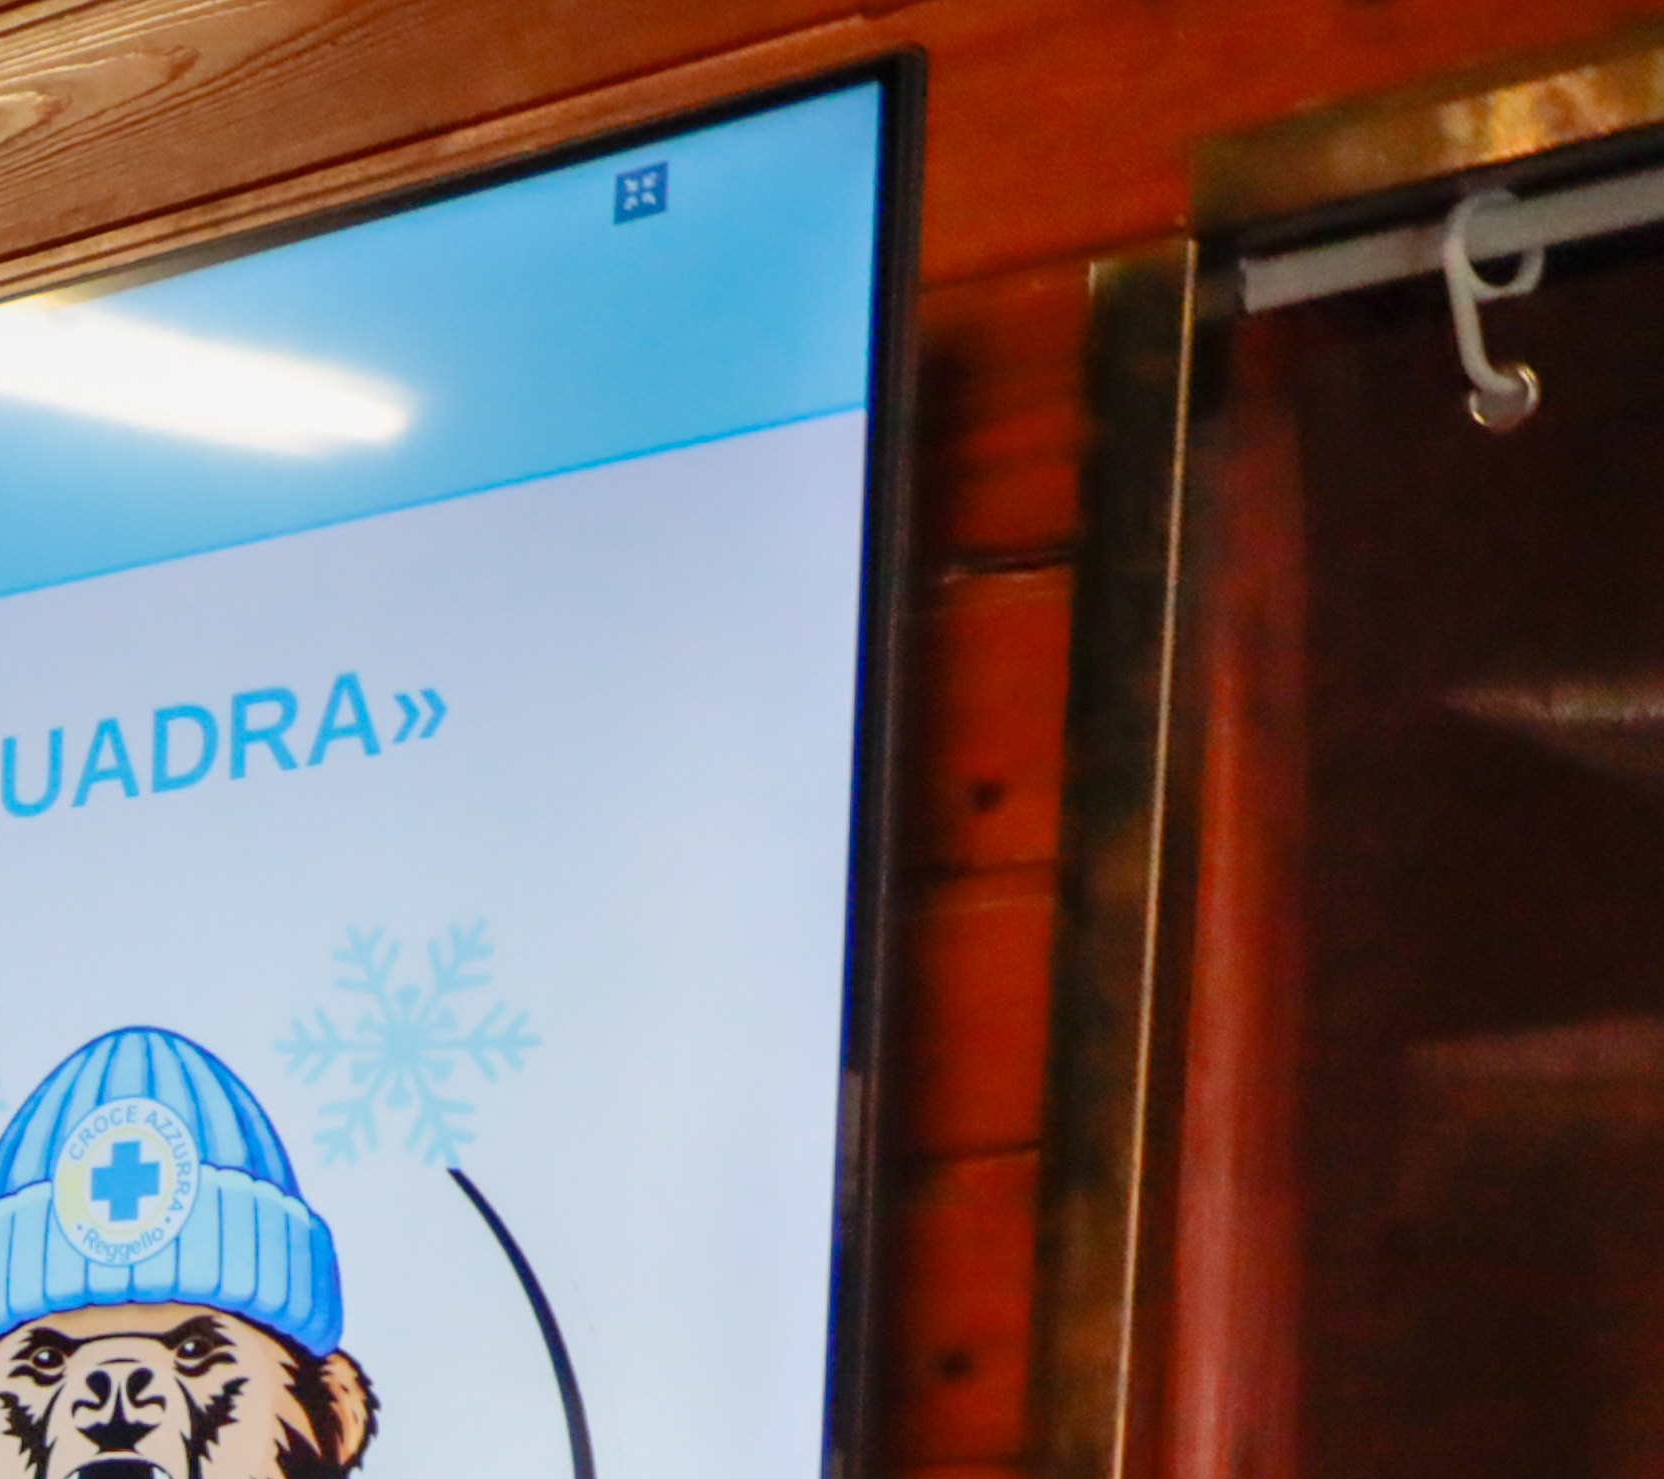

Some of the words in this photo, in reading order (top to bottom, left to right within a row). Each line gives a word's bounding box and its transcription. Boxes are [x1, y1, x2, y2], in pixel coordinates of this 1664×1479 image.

[69, 1105, 138, 1161] CROCE
[145, 1110, 192, 1212] AZZURRA
[83, 1227, 164, 1262] Reggello
